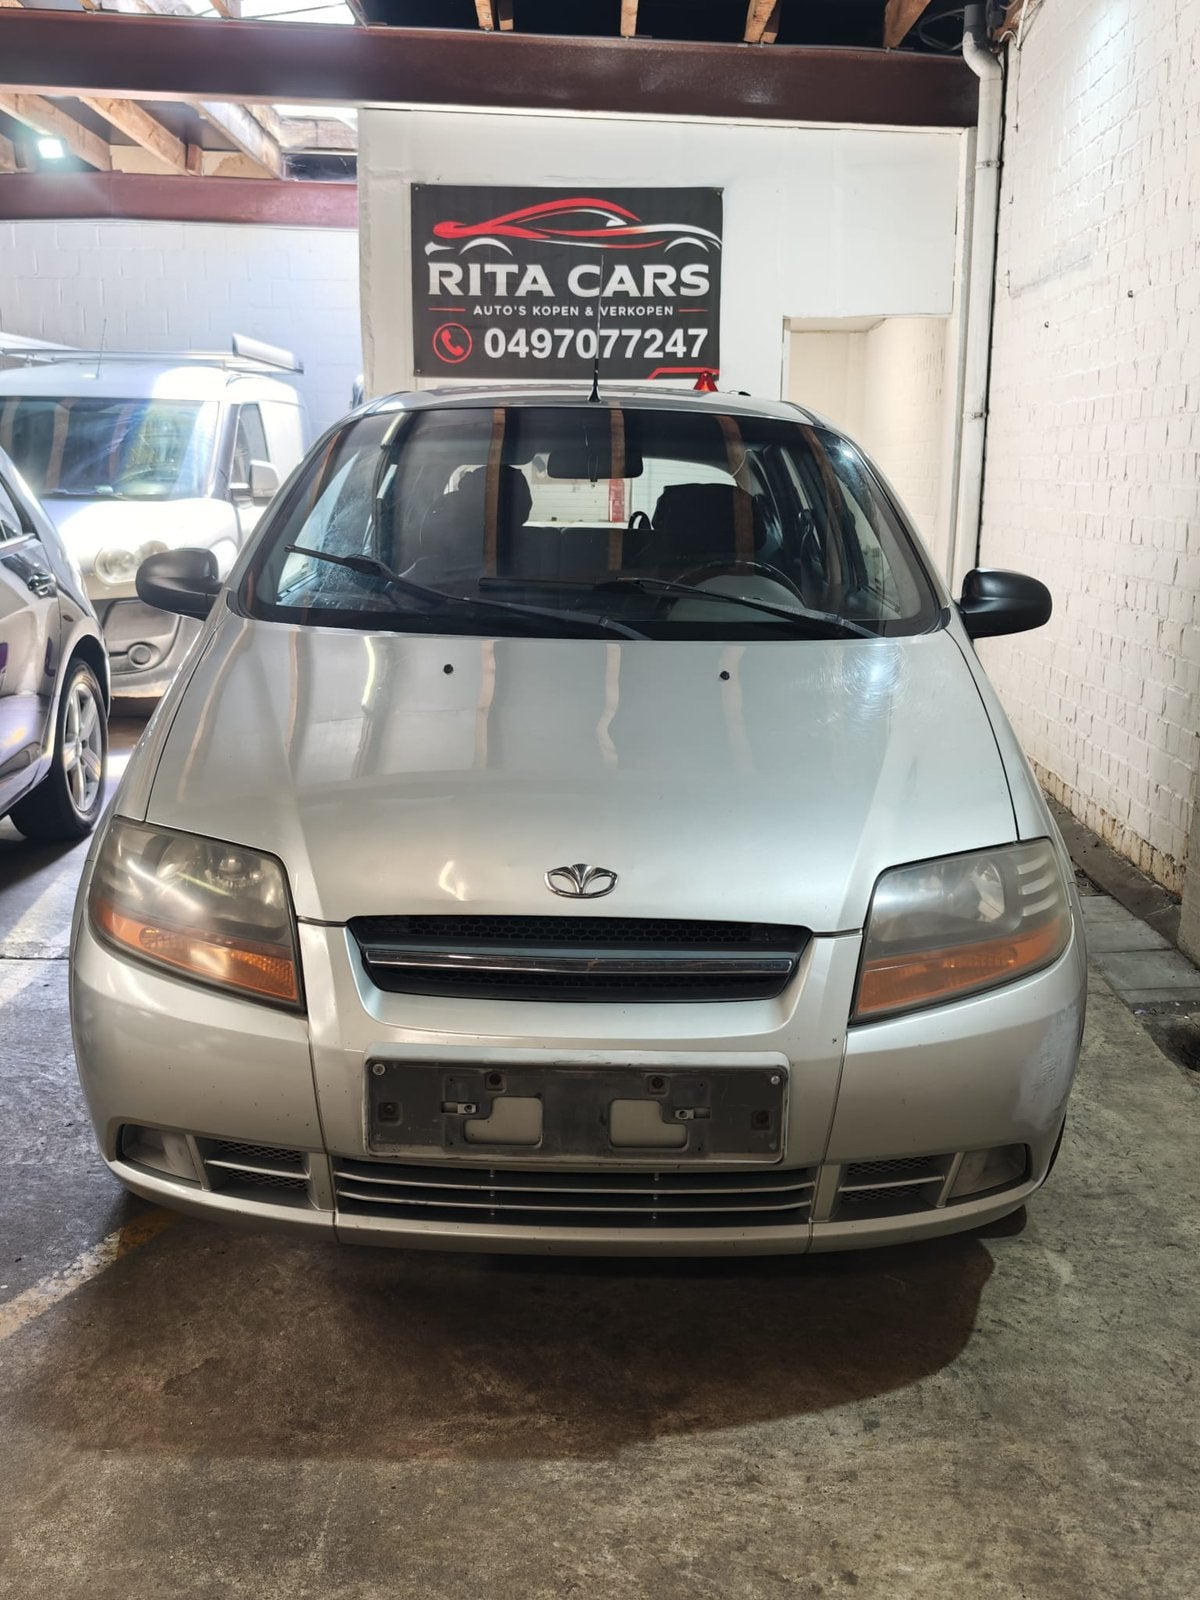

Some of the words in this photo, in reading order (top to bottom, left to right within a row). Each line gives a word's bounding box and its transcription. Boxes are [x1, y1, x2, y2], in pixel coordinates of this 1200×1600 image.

[428, 262, 555, 296] RITA
[567, 263, 710, 297] CARS
[473, 305, 527, 316] AUTO'S
[532, 306, 579, 316] KOPEN
[584, 306, 594, 317] &
[600, 306, 674, 316] VERKOPEN
[484, 327, 708, 359] 0497077247
